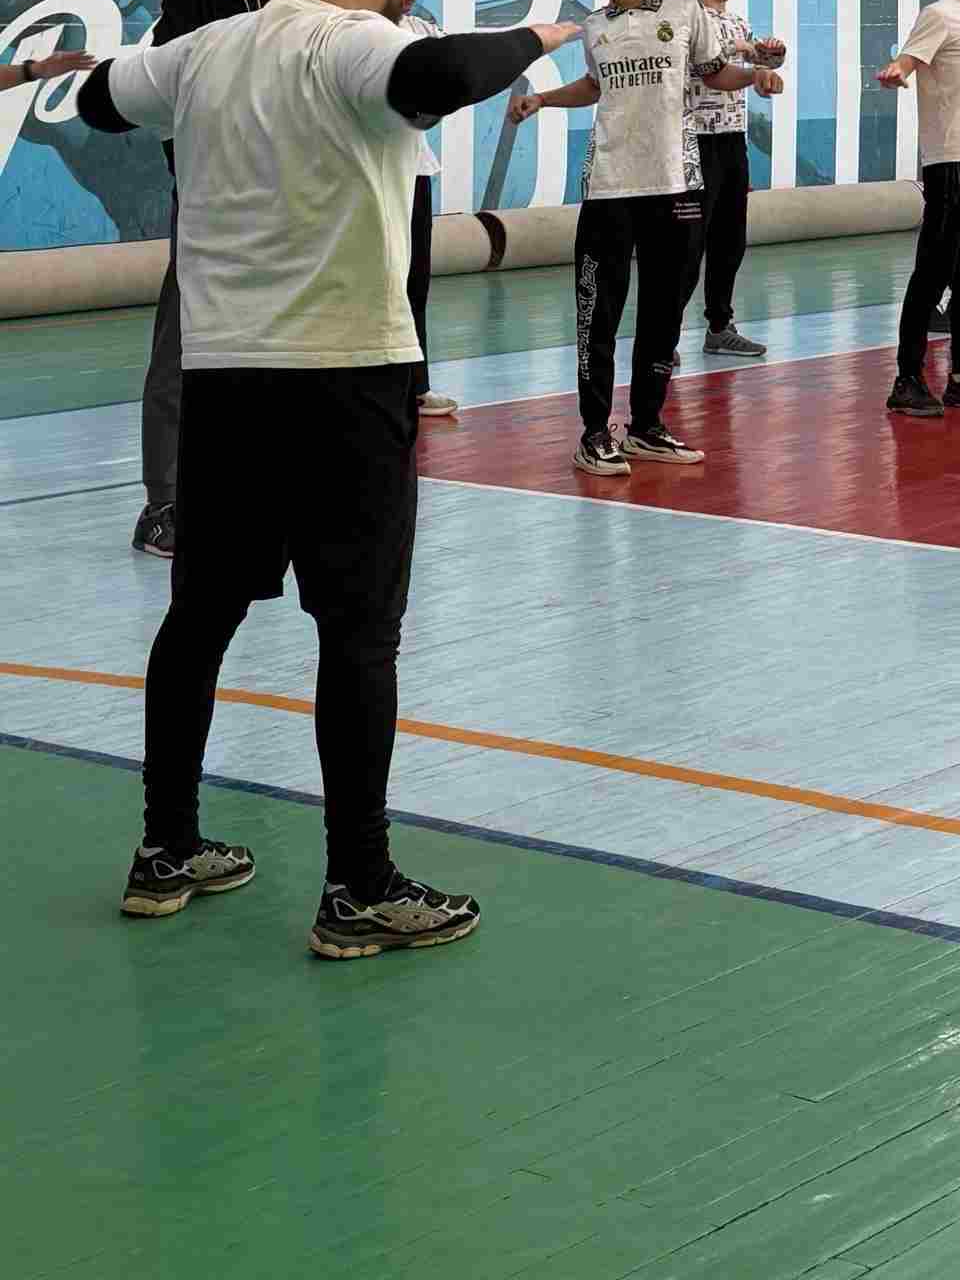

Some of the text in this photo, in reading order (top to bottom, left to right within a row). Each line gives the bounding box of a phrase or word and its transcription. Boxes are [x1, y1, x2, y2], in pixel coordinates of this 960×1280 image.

[599, 55, 672, 79] Emirates
[609, 71, 663, 89] FLY BETTER
